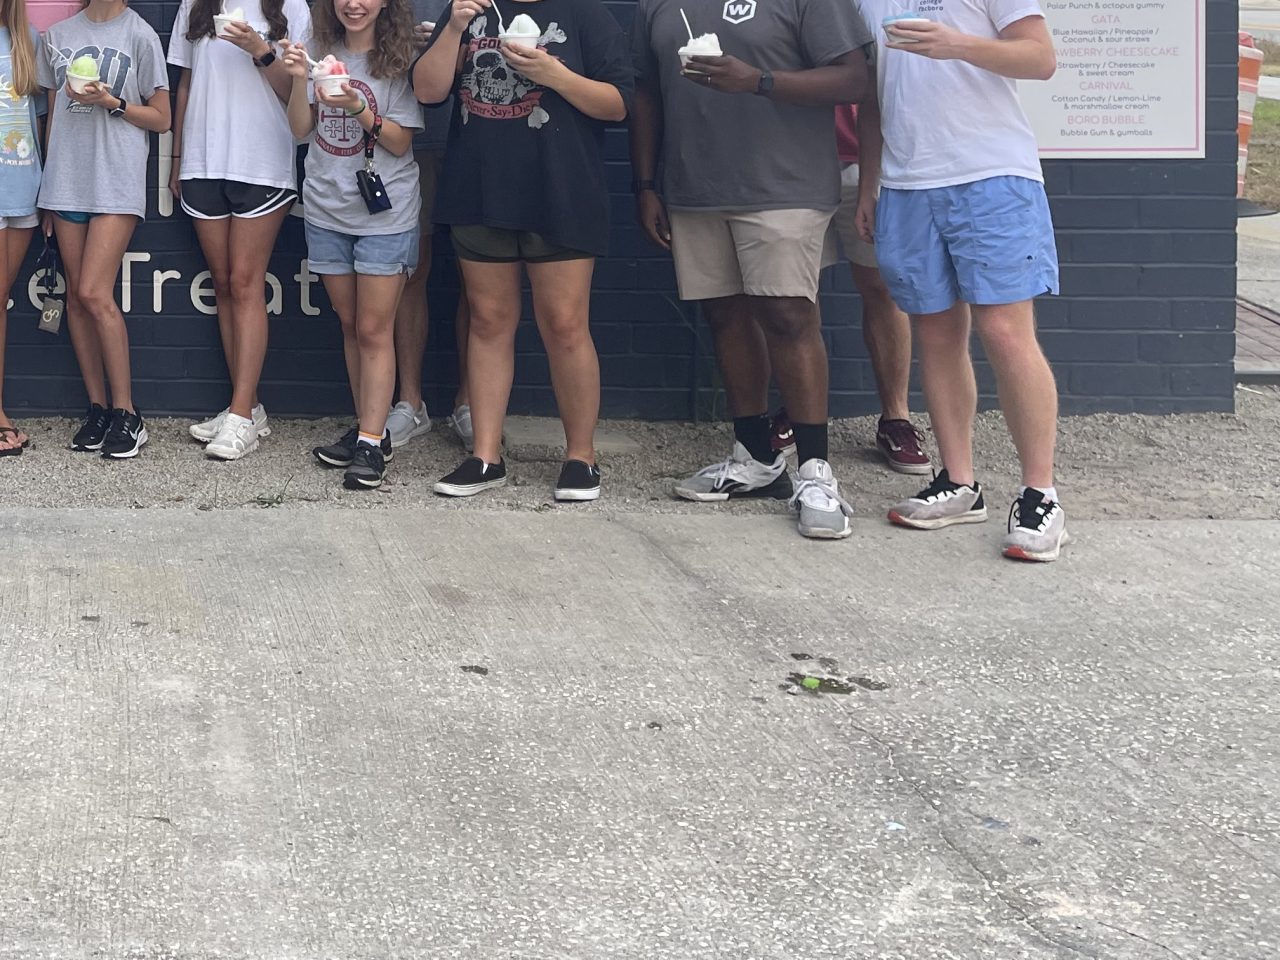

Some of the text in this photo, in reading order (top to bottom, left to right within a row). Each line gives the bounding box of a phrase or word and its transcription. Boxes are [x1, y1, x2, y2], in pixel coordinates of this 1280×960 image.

[729, 4, 751, 16] W
[1046, 2, 1067, 10] Polar
[1102, 2, 1134, 10] octopus
[1136, 2, 1165, 10] gummy
[1091, 15, 1121, 24] GATA
[1052, 28, 1070, 36] Blue
[1071, 28, 1108, 36] Hawaiian
[1115, 28, 1154, 36] Pineapple
[1106, 47, 1179, 57] CHEESECAKE
[1057, 62, 1101, 70] Strawberry
[1108, 61, 1155, 69] Cheesecake
[1079, 81, 1133, 91] CARNIVAL
[1080, 95, 1106, 103] Candy
[490, 105, 507, 118] Say
[1067, 114, 1145, 125] BORO BUBBLE
[1060, 129, 1088, 137] Bubble
[1116, 129, 1153, 137] gumballs
[122, 252, 336, 316] Treat
